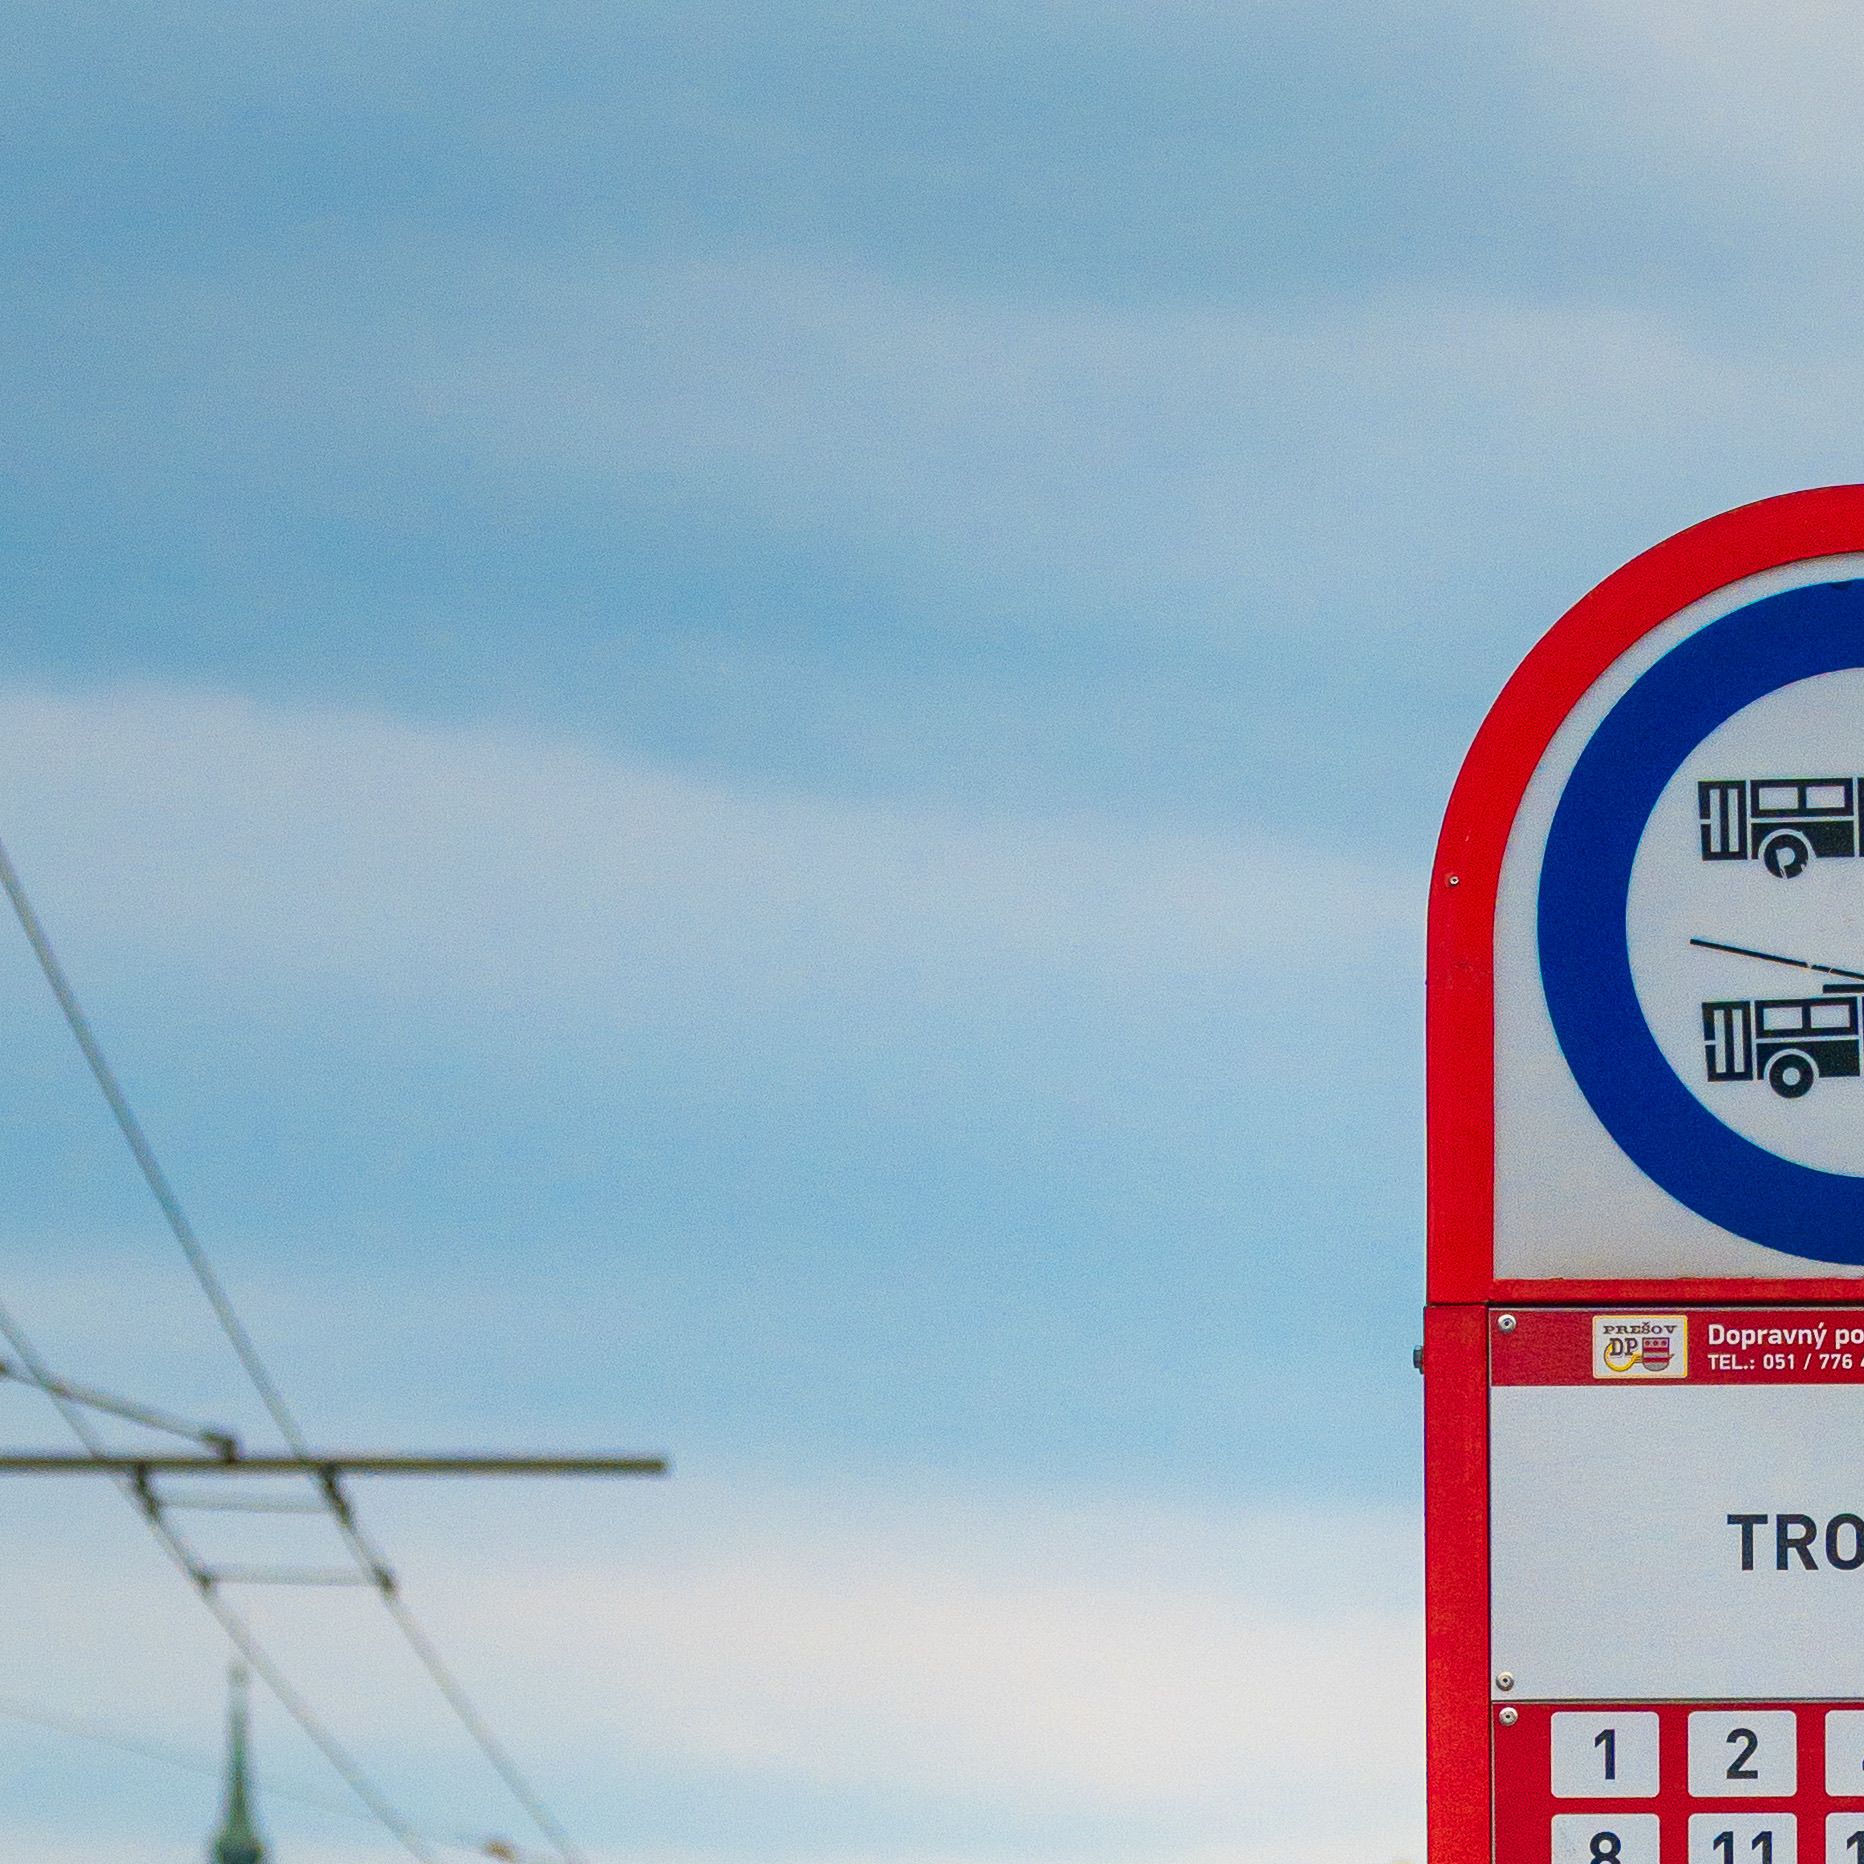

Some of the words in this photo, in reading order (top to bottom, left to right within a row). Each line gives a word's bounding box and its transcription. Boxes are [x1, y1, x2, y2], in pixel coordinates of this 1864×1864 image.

[1603, 1322, 1678, 1335] PREŠOV
[1709, 1324, 1828, 1349] Dopravný
[1610, 1337, 1638, 1356] DP
[1709, 1354, 1755, 1370] TEL.:
[1763, 1354, 1796, 1370] 051
[1804, 1354, 1811, 1370] /
[1819, 1354, 1853, 1370] 776
[1594, 1730, 1616, 1780] 1
[1725, 1728, 1759, 1779] 2
